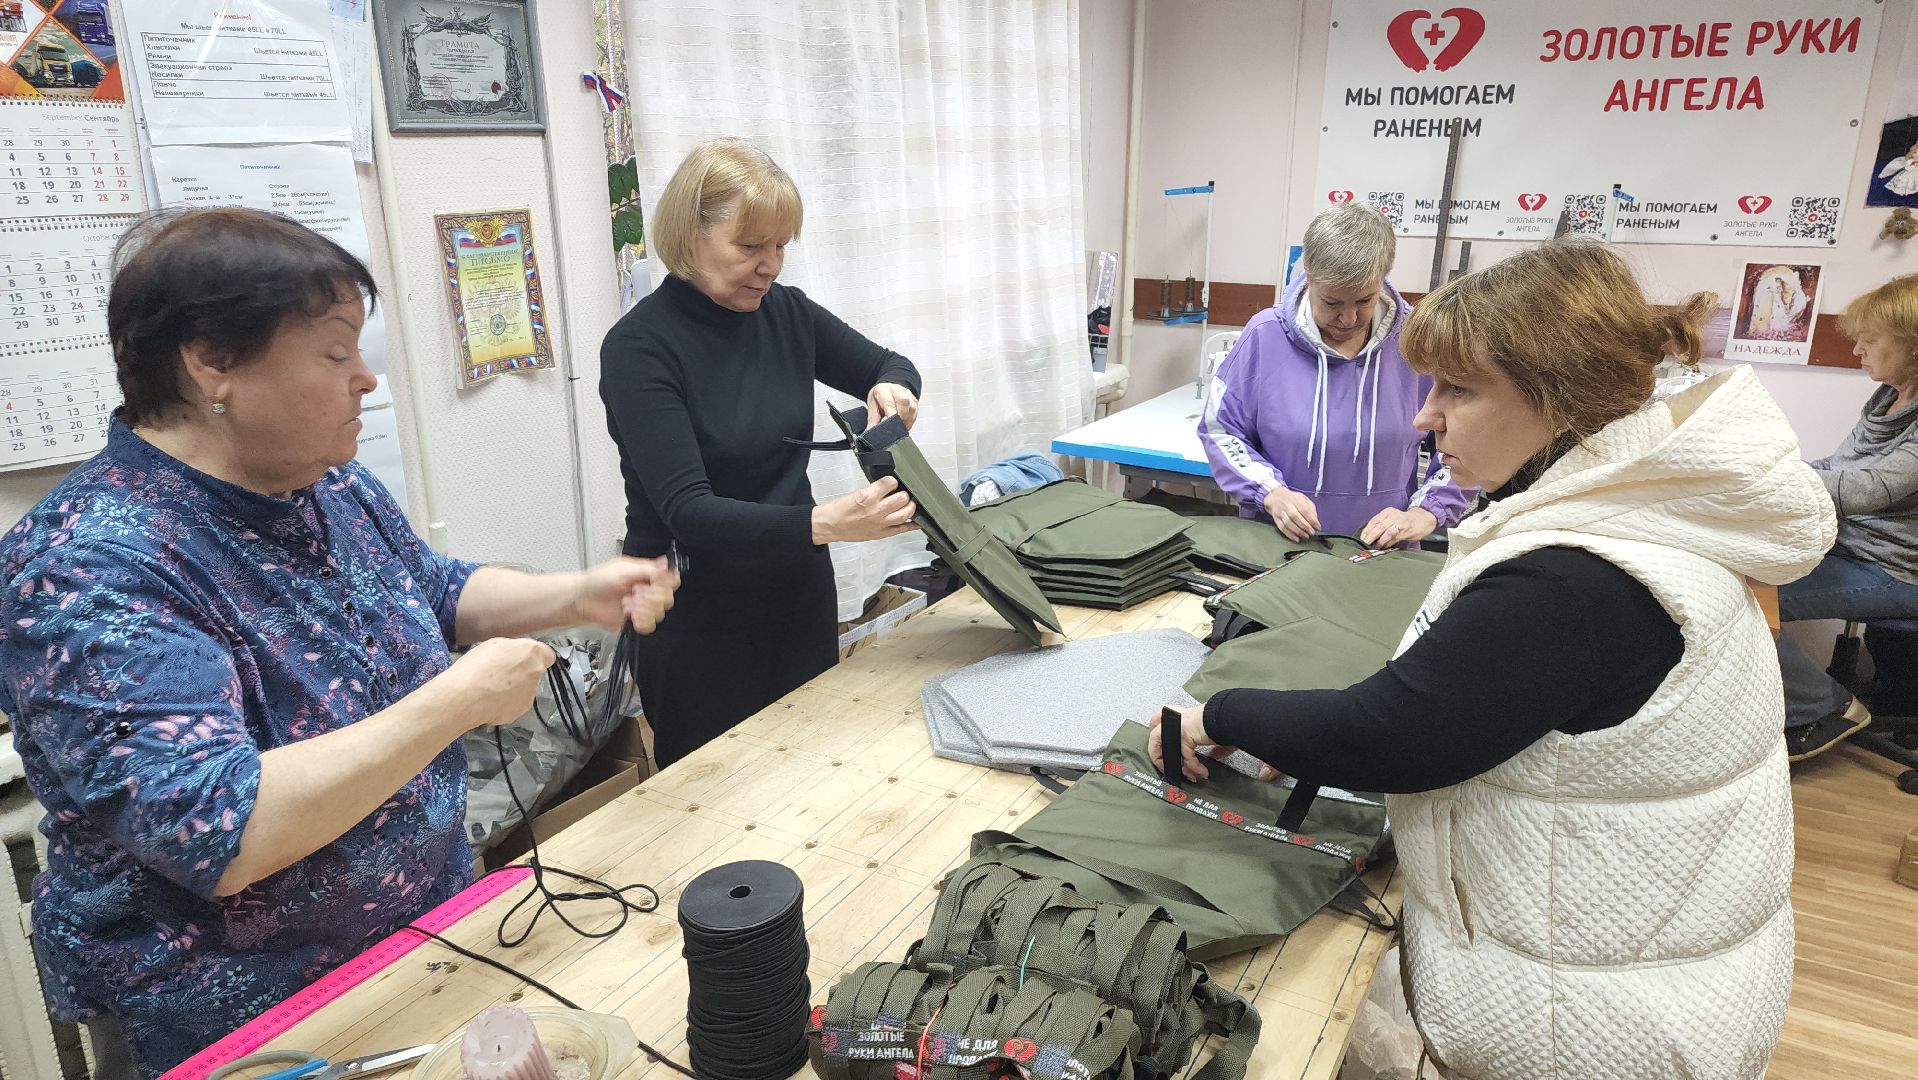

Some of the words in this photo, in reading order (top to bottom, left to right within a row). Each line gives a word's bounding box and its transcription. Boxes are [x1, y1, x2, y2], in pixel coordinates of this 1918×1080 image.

[1540, 22, 1732, 62] ЗОЛОТЫЕ
[1746, 17, 1861, 56] РУКИ
[1345, 87, 1382, 106] МЫ
[1390, 84, 1516, 106] ПОМОГАЕМ
[1604, 76, 1764, 112] АНГЕЛА
[112, 140, 116, 148] 1
[9, 153, 16, 161] 4
[38, 153, 45, 161] 5
[66, 152, 72, 161] 6
[90, 153, 96, 161] 7
[114, 153, 120, 161] 8
[9, 168, 22, 176] 11
[39, 167, 52, 176] 12
[66, 167, 78, 176] 13
[92, 167, 102, 175] 14
[115, 167, 125, 175] 15
[12, 182, 26, 190] 18
[42, 181, 54, 189] 19
[94, 180, 105, 188] 21
[16, 196, 30, 204] 25
[46, 195, 58, 203] 26
[72, 194, 84, 202] 27
[1414, 200, 1434, 210] МЫ
[1438, 200, 1500, 210] МОГАЕМ
[1618, 202, 1640, 212] МЫ
[1645, 202, 1718, 214] ПОМОГАЕМ
[1414, 214, 1468, 224] РАНЕЫМ
[1616, 218, 1680, 230] РАНЕНЫМ
[5, 265, 12, 274] 1
[35, 263, 44, 272] 2
[64, 261, 71, 270] 3
[91, 259, 96, 267] 4
[8, 279, 16, 288] 8
[39, 277, 46, 285] 9
[65, 274, 77, 282] 10
[92, 272, 102, 280] 11
[9, 293, 22, 302] 15
[40, 291, 52, 300] 16
[68, 288, 80, 297] 17
[94, 286, 105, 294] 18
[11, 307, 26, 316] 22
[43, 304, 56, 312] 23
[71, 302, 84, 310] 24
[98, 300, 108, 308] 25
[15, 321, 29, 329] 29
[46, 318, 58, 326] 30
[74, 316, 86, 324] 31
[1734, 344, 1802, 356] НАДЕЖДА
[6, 402, 13, 410] 4
[6, 416, 19, 424] 11
[37, 412, 51, 420] 12
[67, 408, 80, 416] 13
[94, 404, 106, 412] 14
[9, 429, 23, 438] 18
[40, 425, 54, 434] 19
[70, 421, 82, 429] 20
[97, 416, 108, 425] 21
[12, 443, 26, 451] 25
[43, 438, 56, 446] 26
[73, 434, 85, 442] 27
[1124, 774, 1140, 786] РУКИ
[1140, 782, 1164, 798] АНГЕЛА
[1186, 803, 1218, 820] ПРОДАЖИ
[1203, 801, 1218, 811] ДЛЯ
[1262, 831, 1288, 841] АНГЕЛА
[857, 1032, 904, 1042] ЗОЛОТЫЕ
[957, 1038, 970, 1049] НЕ
[972, 1040, 998, 1051] ДЛЯ
[848, 1048, 875, 1058] РУКИ
[876, 1048, 914, 1058] АНГЕЛА
